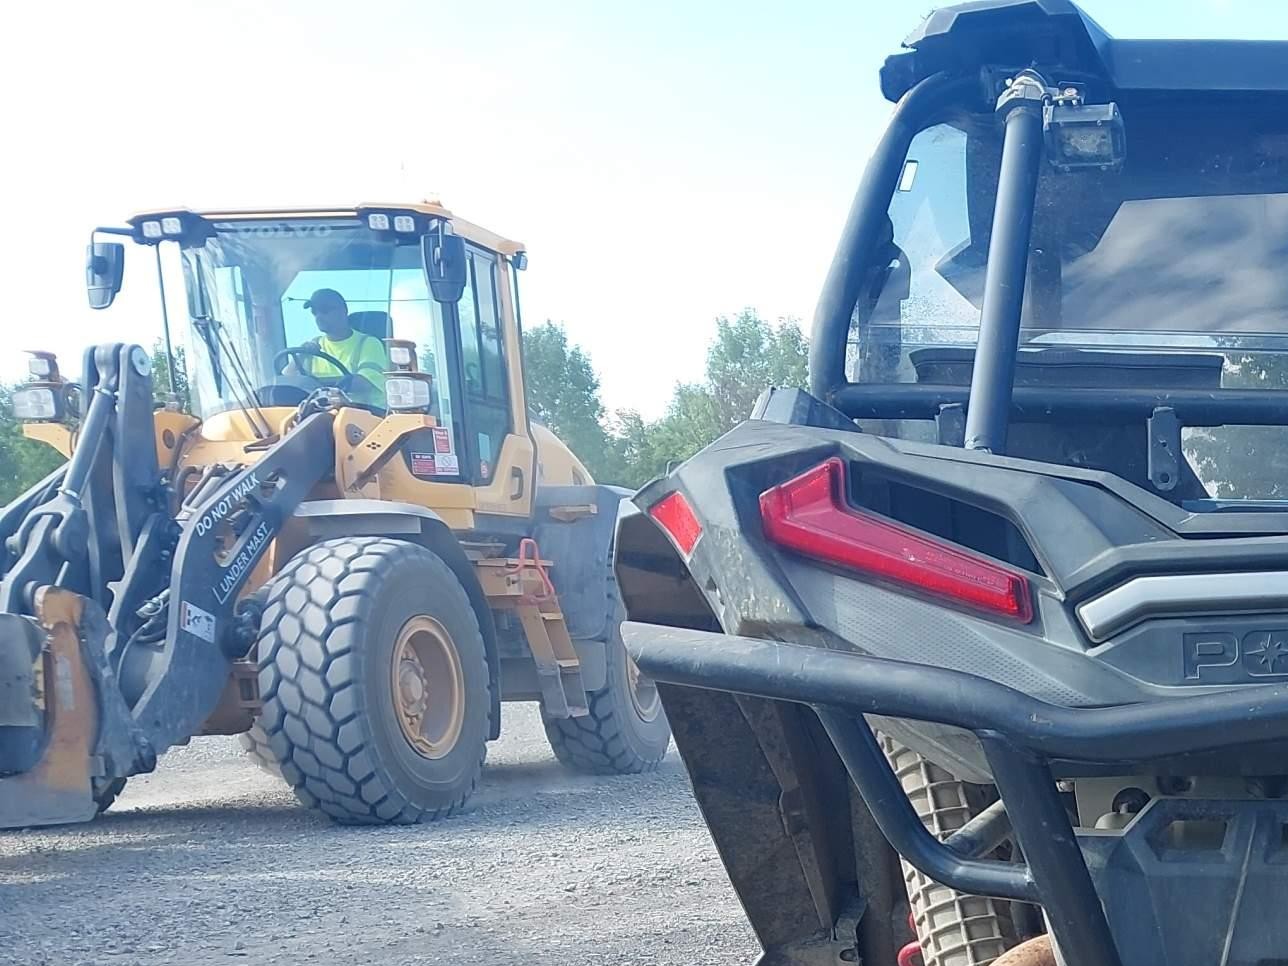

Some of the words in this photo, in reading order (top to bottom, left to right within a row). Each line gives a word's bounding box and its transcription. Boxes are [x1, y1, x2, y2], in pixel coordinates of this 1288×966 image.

[196, 516, 212, 536] DO
[211, 495, 233, 522] NOT
[231, 472, 260, 501] WALK
[222, 552, 249, 592] UNDER
[247, 521, 269, 556] MAST
